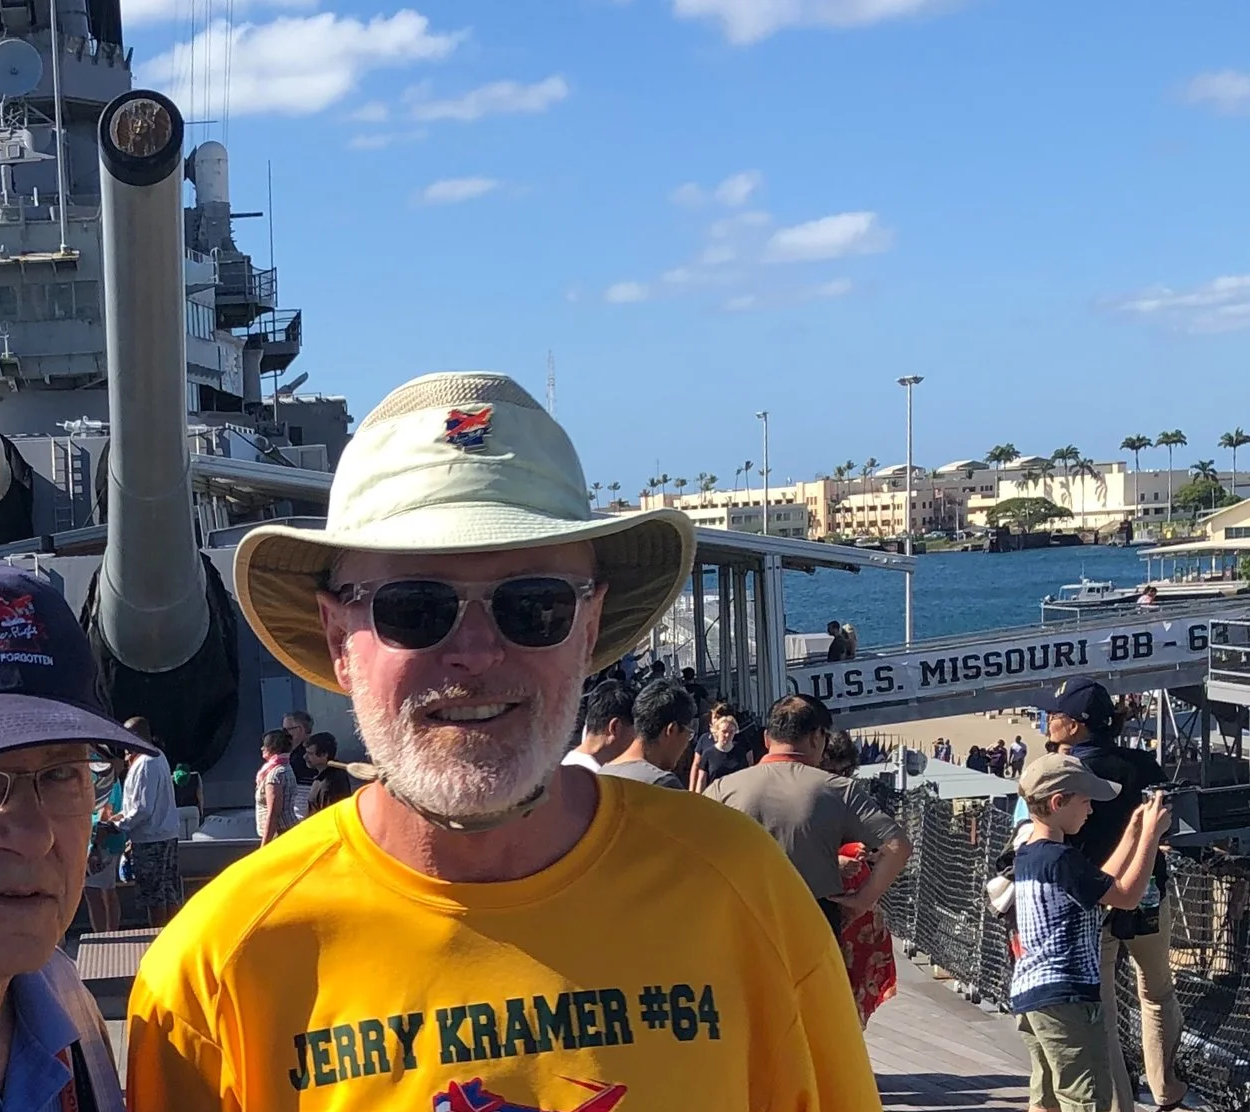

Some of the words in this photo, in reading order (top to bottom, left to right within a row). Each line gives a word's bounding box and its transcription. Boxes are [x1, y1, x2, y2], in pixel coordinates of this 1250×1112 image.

[0, 652, 54, 666] FORGOTTEN
[810, 664, 904, 700] U.S.S.
[918, 638, 1088, 688] MISSOURI
[1109, 630, 1153, 661] BB
[288, 1012, 425, 1091] JERRY
[435, 986, 635, 1065] KRAMER
[639, 983, 721, 1041] #64
